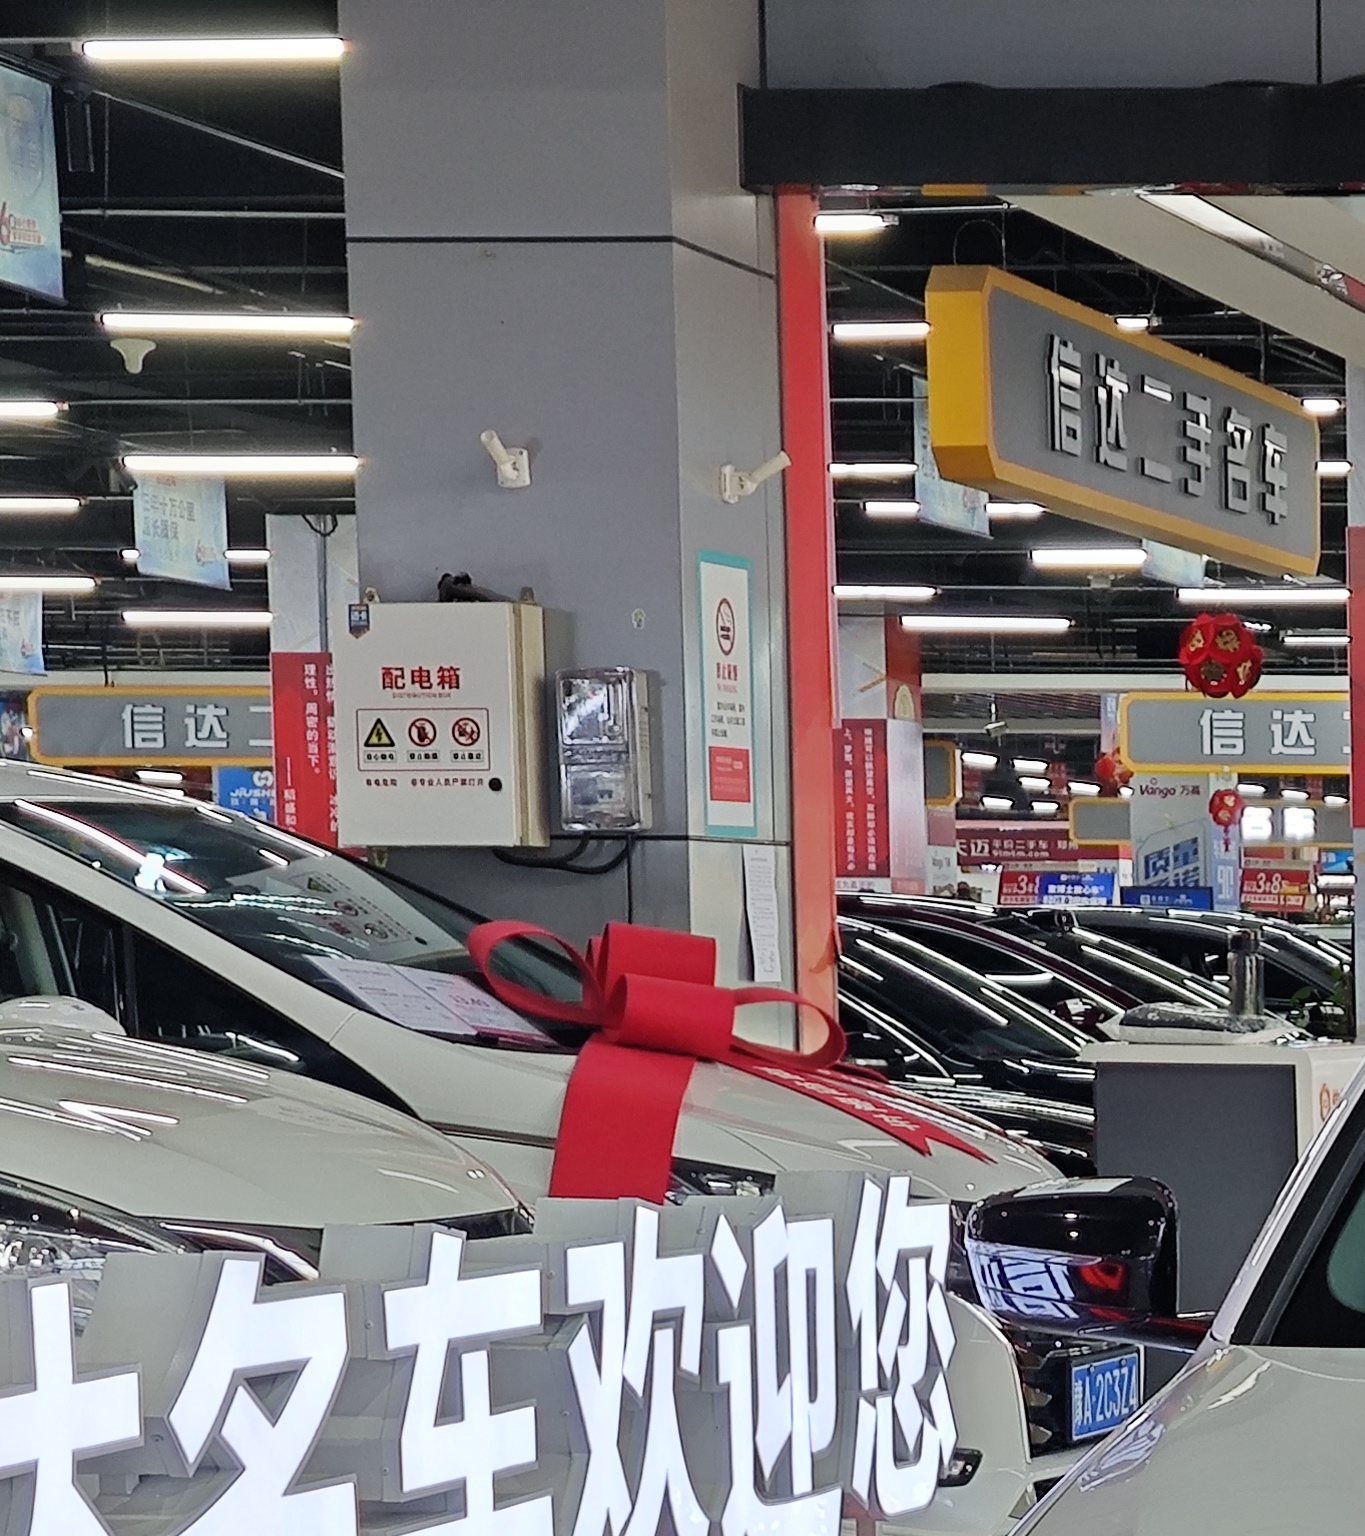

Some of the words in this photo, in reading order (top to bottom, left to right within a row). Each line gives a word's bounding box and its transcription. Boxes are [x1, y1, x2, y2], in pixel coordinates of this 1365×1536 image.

[1044, 333, 1290, 527] 信达二手名车
[381, 666, 461, 690] 配电箱
[1200, 709, 1350, 756] 信达
[1139, 784, 1176, 798] Vango
